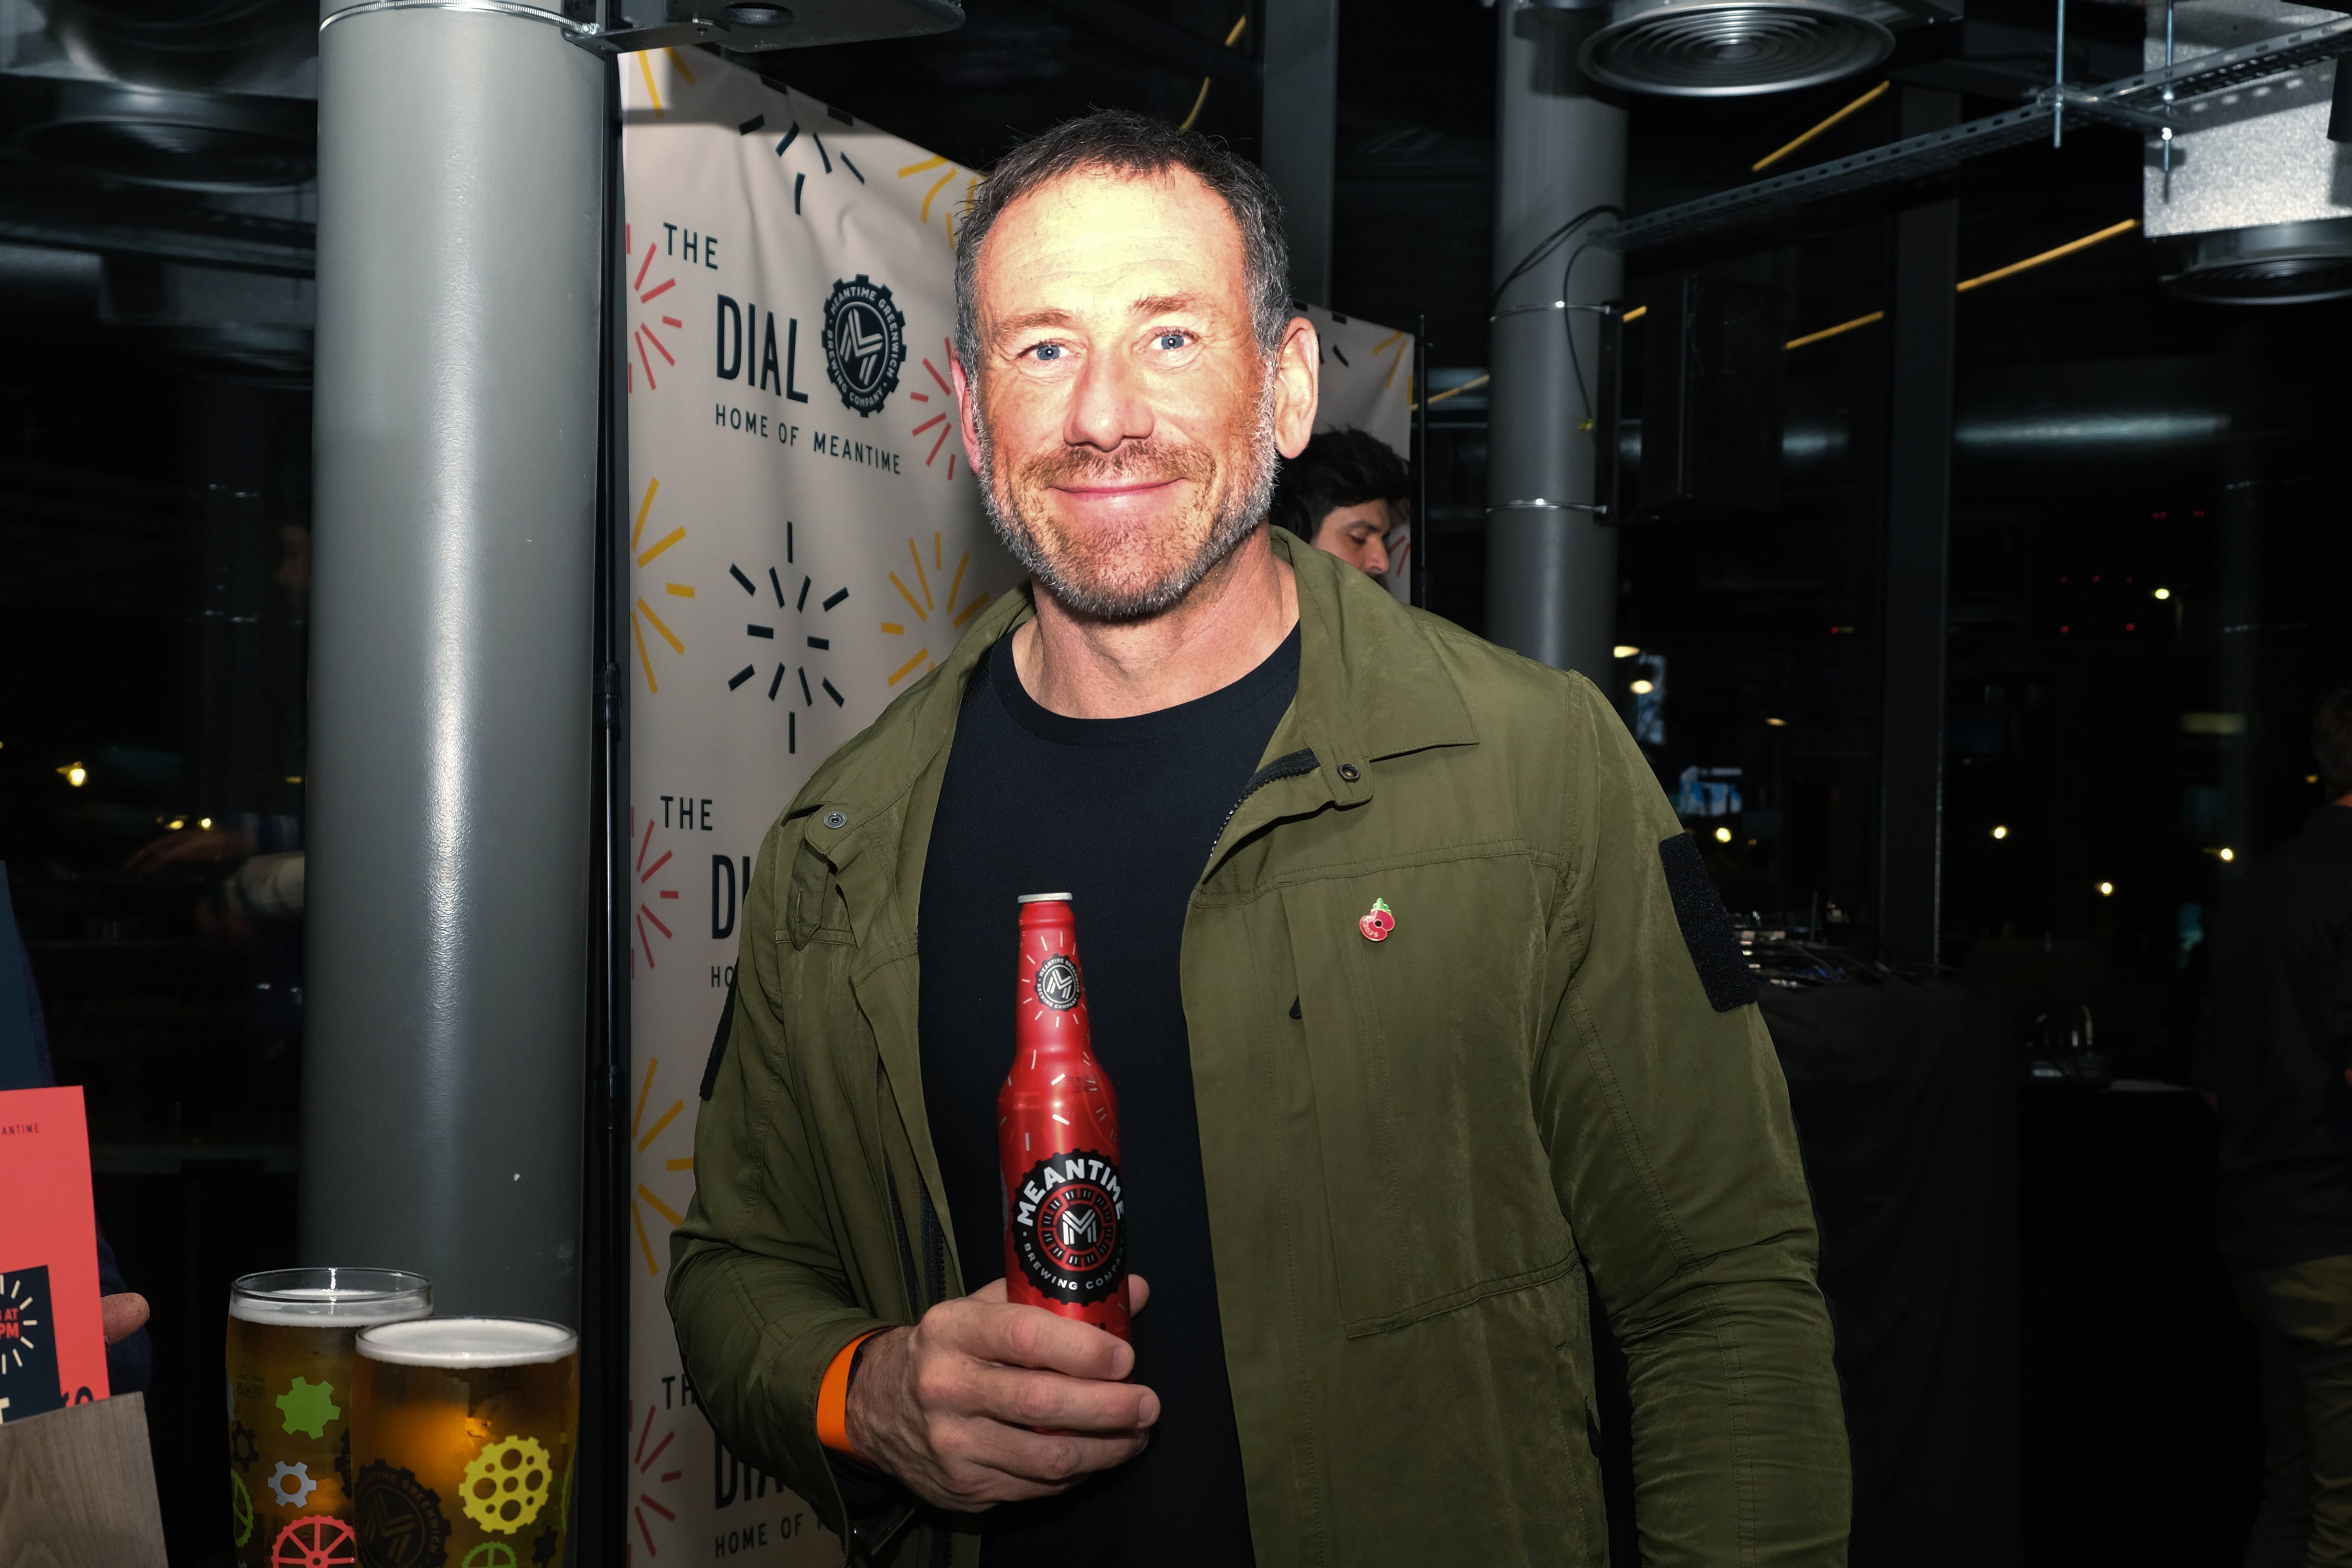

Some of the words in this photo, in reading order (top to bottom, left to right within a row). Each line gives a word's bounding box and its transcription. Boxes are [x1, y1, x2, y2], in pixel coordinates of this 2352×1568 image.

[663, 221, 719, 270] THE
[716, 293, 809, 404] DIAL
[830, 286, 877, 316] MEANTIME
[878, 298, 900, 378] GREENWICH
[826, 329, 847, 394] BREWING
[849, 386, 884, 407] COMPANY
[715, 402, 768, 439] HOME
[778, 422, 800, 447] OF
[813, 431, 901, 475] MEANTIME
[660, 795, 713, 832] THE
[711, 854, 751, 940] DI
[710, 965, 735, 988] HO
[1039, 958, 1064, 977] MEANTIME
[1, 1122, 39, 1135] ANTIME
[1017, 1158, 1124, 1227] MEANTIME
[1024, 1242, 1079, 1290] BREWING
[4, 1307, 20, 1322] AT
[661, 1374, 696, 1410] TH
[401, 1480, 441, 1553] GREENWICH
[714, 1523, 768, 1559] HOME
[780, 1513, 803, 1540] OF
